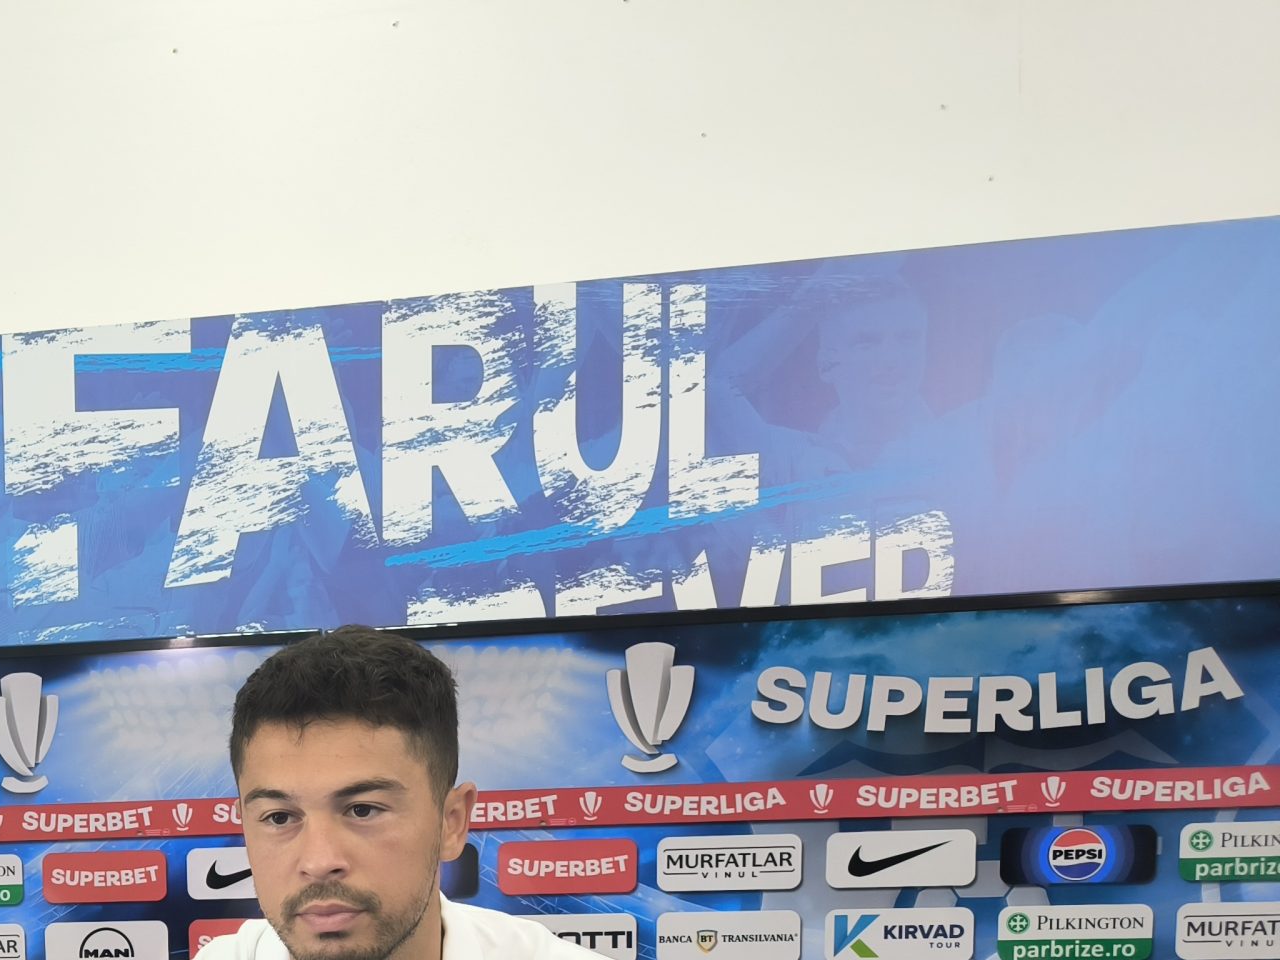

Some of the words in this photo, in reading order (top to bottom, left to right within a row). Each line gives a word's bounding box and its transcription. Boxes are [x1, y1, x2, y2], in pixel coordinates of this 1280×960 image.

[1, 281, 760, 601] FARUL
[750, 646, 1245, 733] SUPERLIGA
[855, 780, 1019, 810] SUPERBET
[1089, 771, 1271, 802] SUPERLIGA
[470, 794, 558, 822] ERBET
[623, 787, 787, 816] SUPERLIGA
[21, 806, 153, 833] SUPERBET
[507, 854, 629, 878] SUPERBET
[666, 852, 793, 869] MURFATLAR
[1052, 848, 1103, 860] PEPSI
[51, 865, 159, 887] SUPERBET
[557, 931, 633, 949] OTTI
[659, 934, 693, 944] BANCA
[700, 935, 714, 943] BT
[883, 924, 965, 940] KIRVAD
[83, 948, 130, 958] MAN
